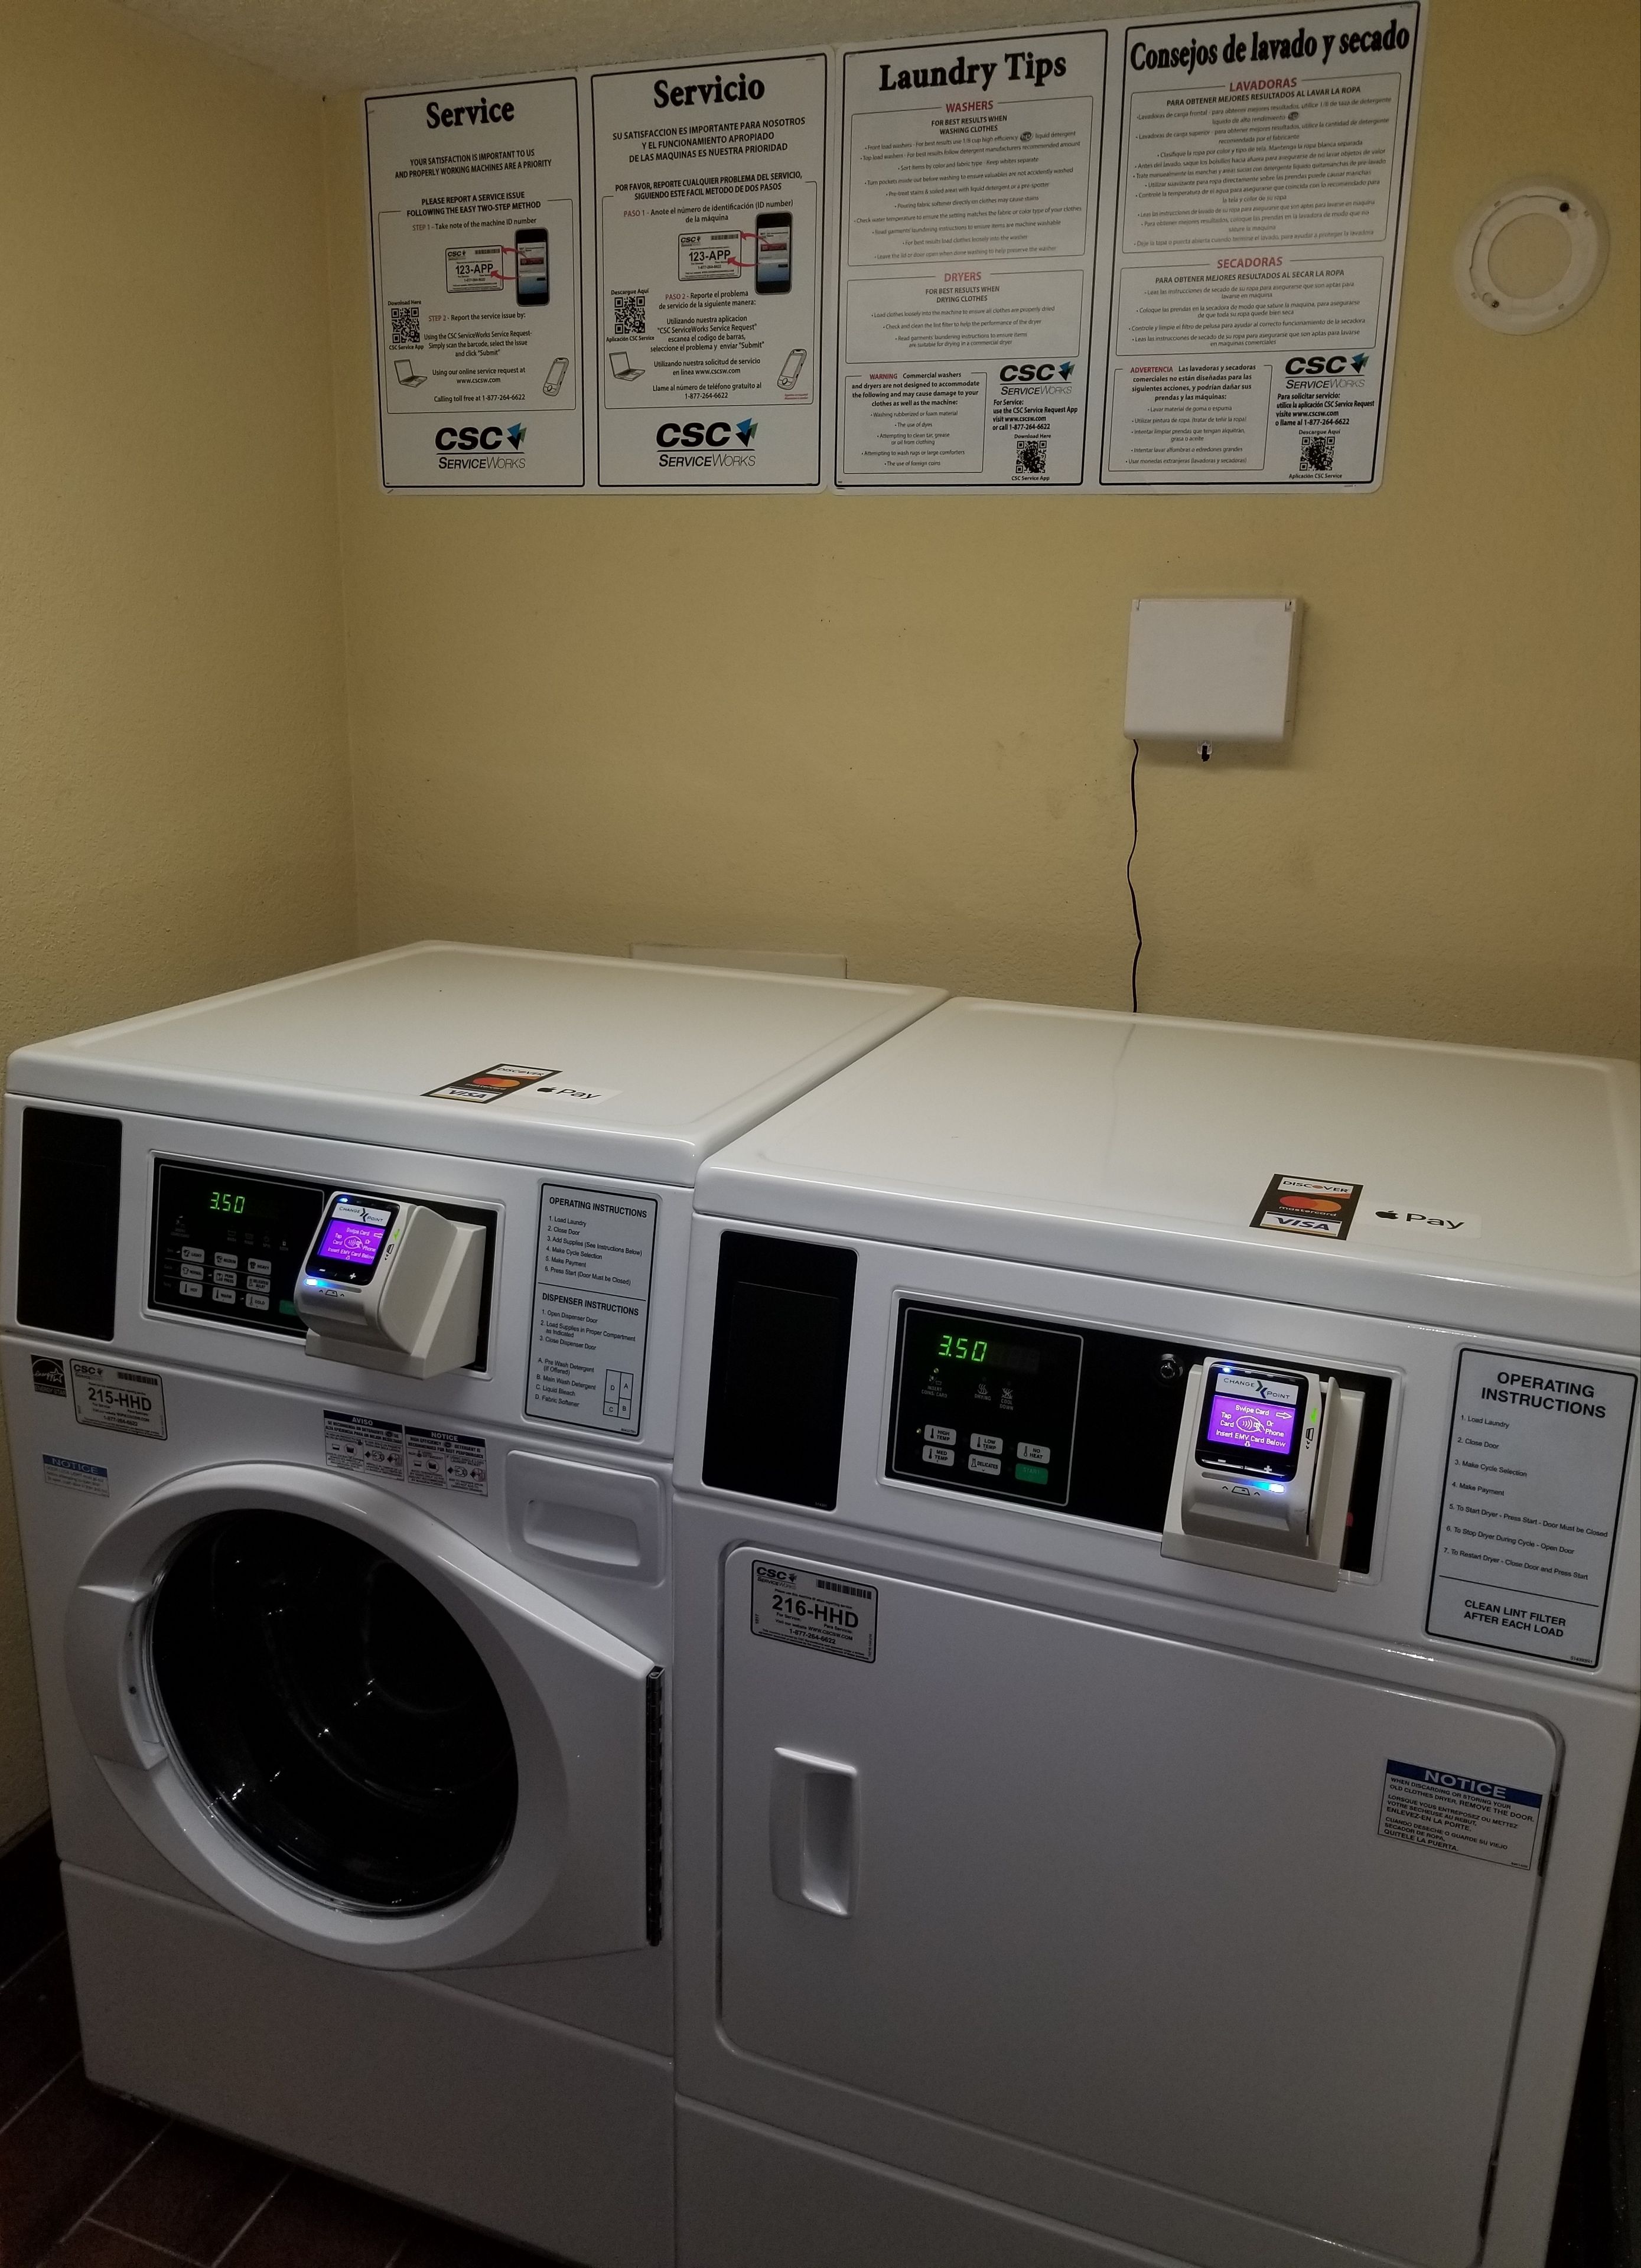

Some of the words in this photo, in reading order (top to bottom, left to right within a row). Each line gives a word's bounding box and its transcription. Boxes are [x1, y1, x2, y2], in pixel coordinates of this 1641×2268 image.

[1130, 38, 1217, 74] Consejos
[1222, 32, 1247, 64] de
[1250, 27, 1317, 61] lavado
[1321, 34, 1336, 64] y
[1339, 19, 1410, 54] secado
[878, 56, 998, 92] Laundry
[1004, 53, 1066, 86] Tips
[653, 73, 765, 109] Servicio
[1229, 77, 1297, 92] LAVADORAS
[1186, 96, 1217, 105] OBTENER
[1217, 94, 1249, 103] MEJORES
[1251, 91, 1295, 100] RESULTADOS
[1307, 88, 1330, 96] LAVAR
[1342, 86, 1360, 94] ROPA
[426, 97, 515, 129] Service
[945, 100, 994, 113] WASHERS
[612, 132, 622, 141] SU
[624, 127, 677, 139] SATISFACCION
[679, 126, 688, 135] ES
[689, 122, 738, 134] IMPORTANTE
[740, 120, 761, 130] PARA
[762, 116, 805, 128] NOSOTROS
[939, 126, 969, 135] WASHING
[970, 124, 998, 133] CLOTHES
[961, 116, 987, 125] RESULTS
[642, 142, 647, 150] Y
[648, 141, 657, 149] EL
[658, 135, 727, 149] FUNCIONAMIENTO
[728, 132, 774, 143] APROPIADO
[410, 158, 427, 166] YOUR
[428, 154, 471, 165] SATISFACTION
[478, 150, 515, 161] IMPORTANT
[516, 149, 525, 158] TO
[526, 148, 535, 157] US
[629, 154, 639, 163] DE
[640, 153, 654, 162] LAS
[656, 149, 696, 161] MAQUINAS
[698, 149, 706, 157] ES
[708, 146, 743, 157] NUESTRA
[745, 142, 787, 154] PRIORIDAD
[395, 171, 408, 179] AND
[409, 168, 439, 178] PROPERLY
[439, 165, 470, 175] WORKING
[471, 162, 503, 172] MACHINES
[504, 162, 516, 170] ARE
[523, 159, 552, 168] PRIORITY
[688, 249, 731, 262] 123-APP
[1217, 256, 1283, 269] SECADORAS
[455, 263, 494, 275] 123-APP
[944, 271, 982, 282] DRYERS
[999, 363, 1057, 383] CSC
[1285, 356, 1349, 377] CSC
[435, 426, 503, 451] CSC
[656, 422, 731, 448] CSC
[497, 1067, 545, 1076] DISCOVER
[449, 1090, 487, 1099] VISA
[556, 1089, 601, 1099] Pay
[1283, 1181, 1349, 1193] DISCOVER
[210, 1192, 245, 1214] 3.50
[549, 1197, 591, 1210] OPERATING
[592, 1203, 647, 1218] INSTRUCTIONS
[1279, 1206, 1337, 1217] mastercard
[1272, 1216, 1330, 1231] VISA
[1406, 1213, 1464, 1229] Pay
[542, 1292, 583, 1306] DISPENSER
[584, 1299, 639, 1316] INSTRUCTIONS
[938, 1335, 987, 1362] 3.50
[74, 1364, 96, 1374] CSC
[1224, 1378, 1255, 1387] CHANGE
[1267, 1391, 1290, 1399] POINT
[1497, 1371, 1594, 1399] OPERATING
[87, 1387, 152, 1411] 215-HHD
[1481, 1387, 1606, 1418] INSTRUCTIONS
[1221, 1412, 1232, 1420] Tap
[1235, 1405, 1254, 1414] Swipe
[1255, 1407, 1269, 1416] Card
[352, 1417, 373, 1426] AVISO
[1467, 1415, 1483, 1423] Load
[1484, 1418, 1510, 1429] Laundry
[431, 1432, 458, 1441] NOTICE
[1251, 1435, 1264, 1443] Card
[1266, 1438, 1286, 1447] Below
[1265, 1428, 1284, 1437] Phone
[52, 1458, 99, 1475] NOTICE
[977, 1461, 998, 1469] DELICATES
[756, 1567, 787, 1580] CSC
[771, 1594, 858, 1628] 216-HHD
[1464, 1599, 1500, 1614] CLEAN
[1503, 1606, 1528, 1618] LINT
[1529, 1612, 1566, 1627] FILTER
[1463, 1611, 1499, 1625] AFTER
[1501, 1618, 1531, 1631] EACH
[1533, 1624, 1564, 1637] LOAD
[1391, 1777, 1410, 1786] WHEN
[1411, 1782, 1450, 1795] DISCARDING
[1463, 1794, 1492, 1805] STORING
[1493, 1801, 1511, 1810] YOUR
[1425, 1770, 1506, 1799] NOTICE
[1404, 1787, 1434, 1798] CLOTHES
[1434, 1794, 1457, 1805] DRYER,
[1459, 1800, 1492, 1812] REMOVE
[1493, 1807, 1508, 1816] THE
[1510, 1811, 1534, 1822] DOOR.
